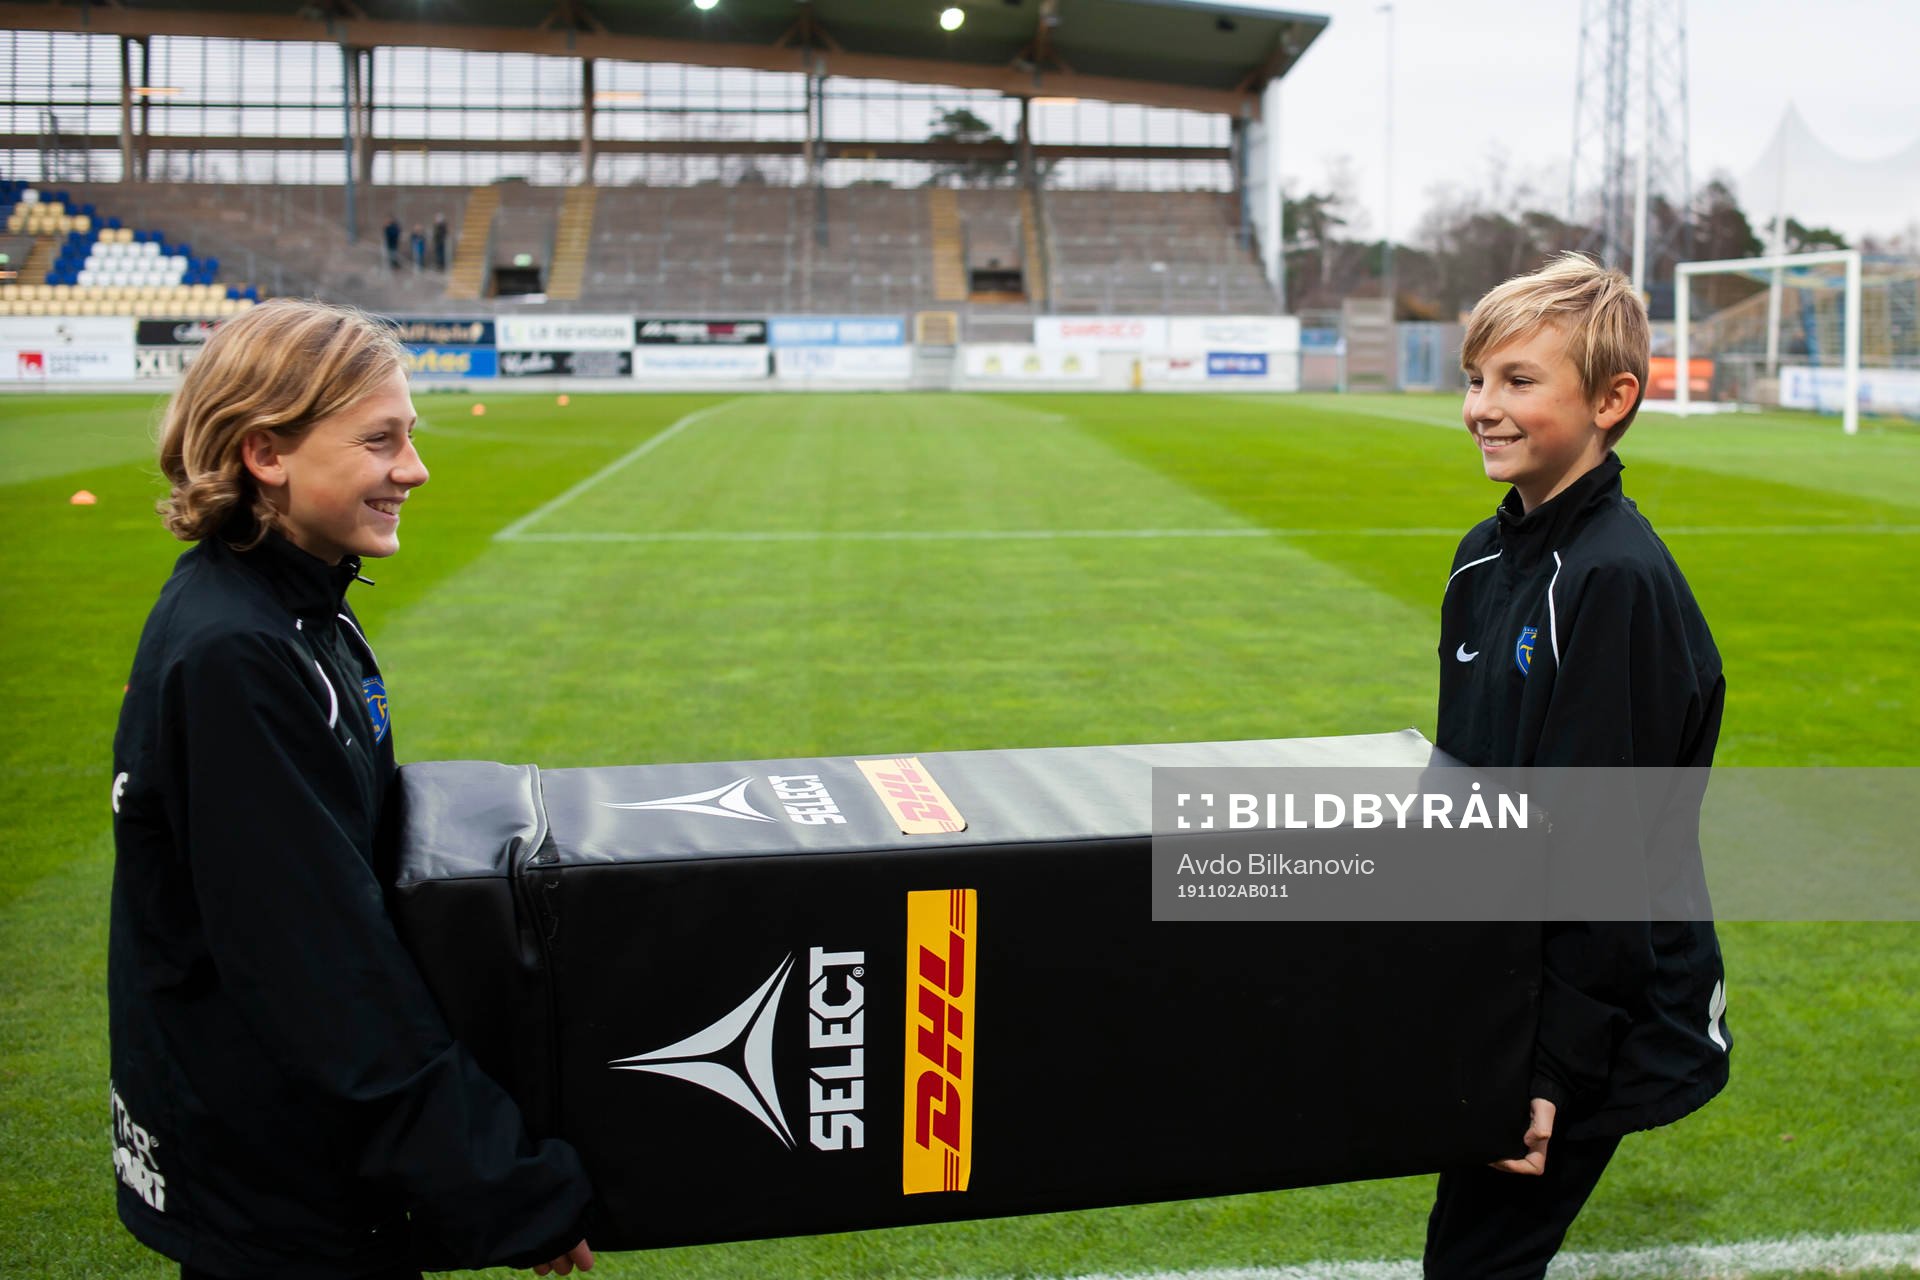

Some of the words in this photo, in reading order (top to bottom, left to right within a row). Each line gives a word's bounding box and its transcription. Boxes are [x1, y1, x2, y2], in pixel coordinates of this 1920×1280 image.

[768, 774, 847, 826] SELECT
[875, 771, 952, 823] DHL
[915, 930, 965, 1152] DHL
